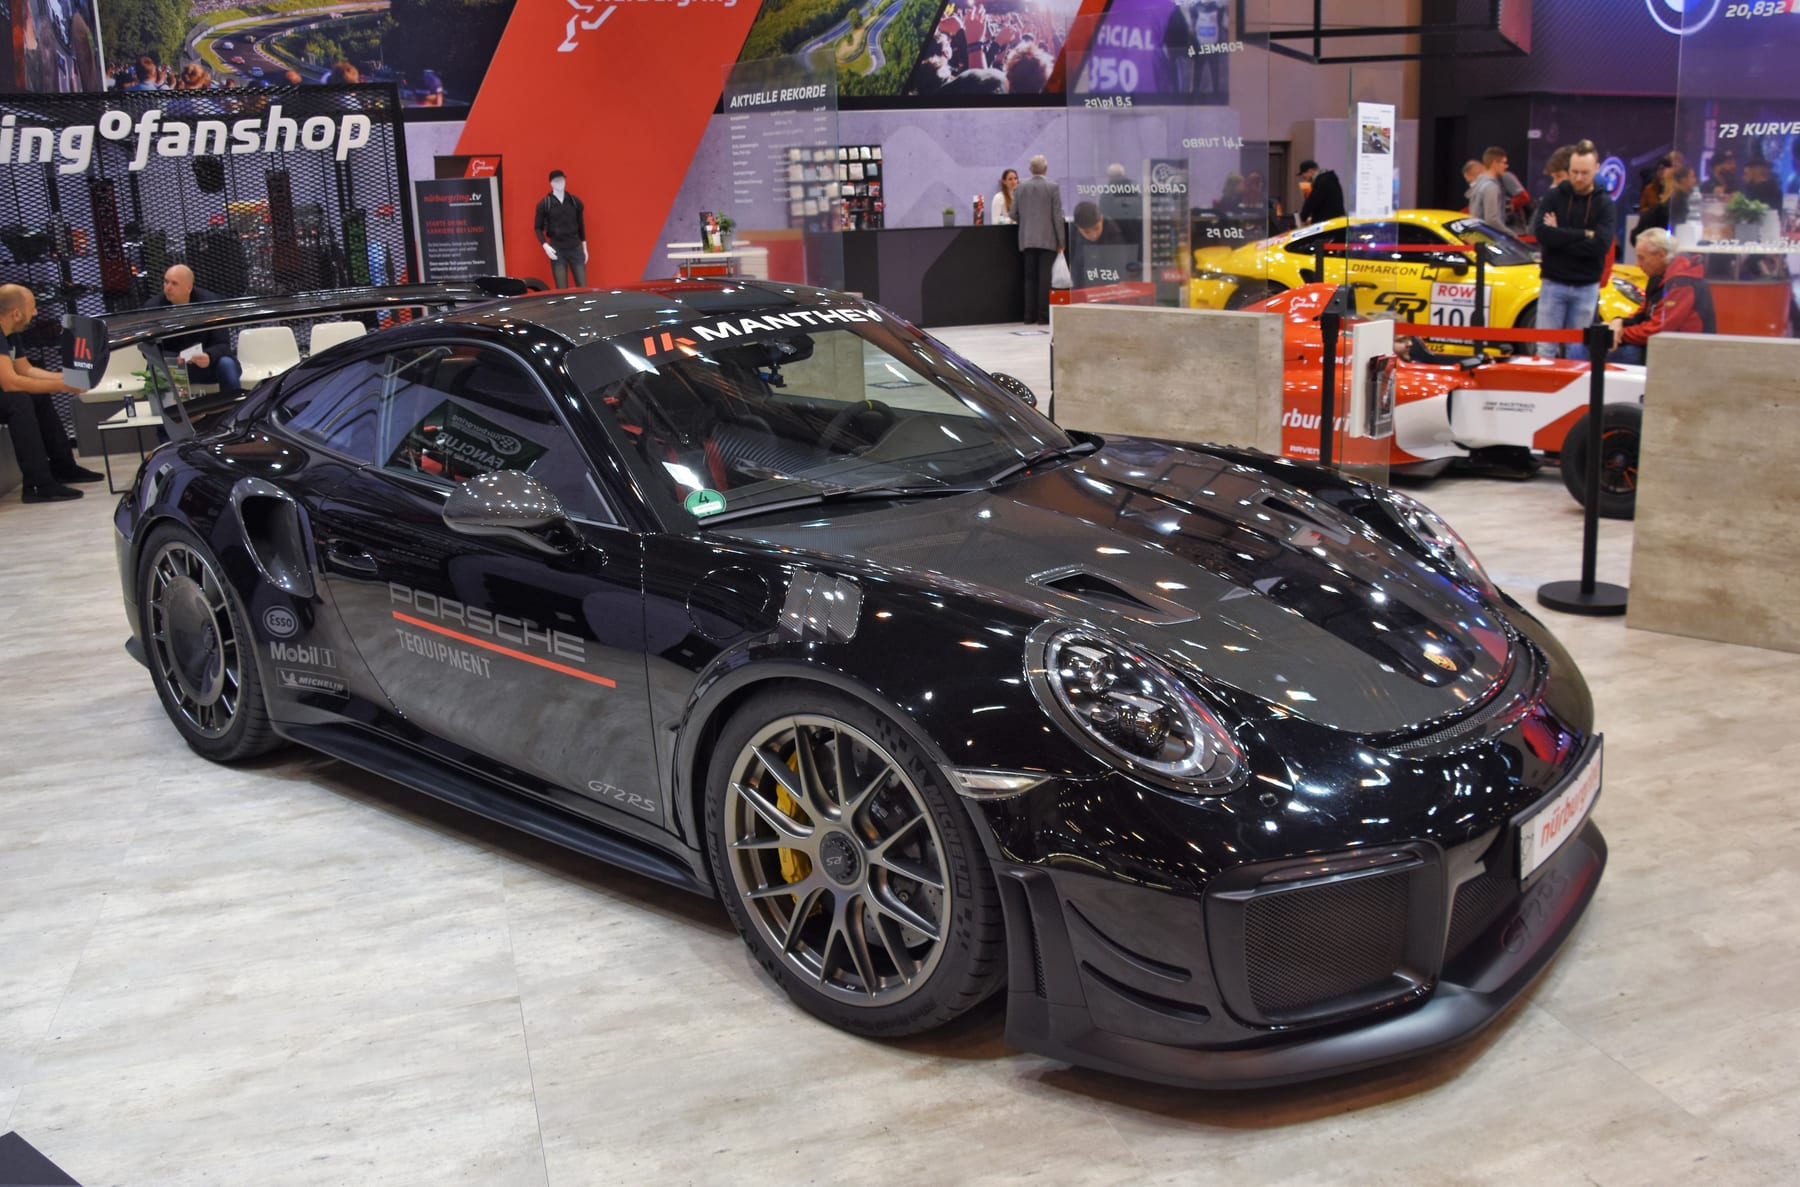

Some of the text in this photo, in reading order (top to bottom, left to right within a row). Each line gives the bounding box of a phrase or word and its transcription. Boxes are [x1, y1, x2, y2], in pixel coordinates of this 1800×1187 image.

[1725, 1, 1785, 19] 20,832
[730, 84, 827, 108] AKTUELLE REKORDE
[1718, 123, 1739, 139] 73
[1351, 263, 1419, 277] DIMARCON
[1437, 284, 1476, 298] ROW
[691, 308, 884, 342] MANTHEY
[389, 580, 586, 664] PORSCHE
[269, 640, 319, 666] Mobil
[395, 628, 492, 680] TEQUIPMENT
[298, 676, 344, 692] MICHELIN
[924, 784, 973, 899] MICHELIN
